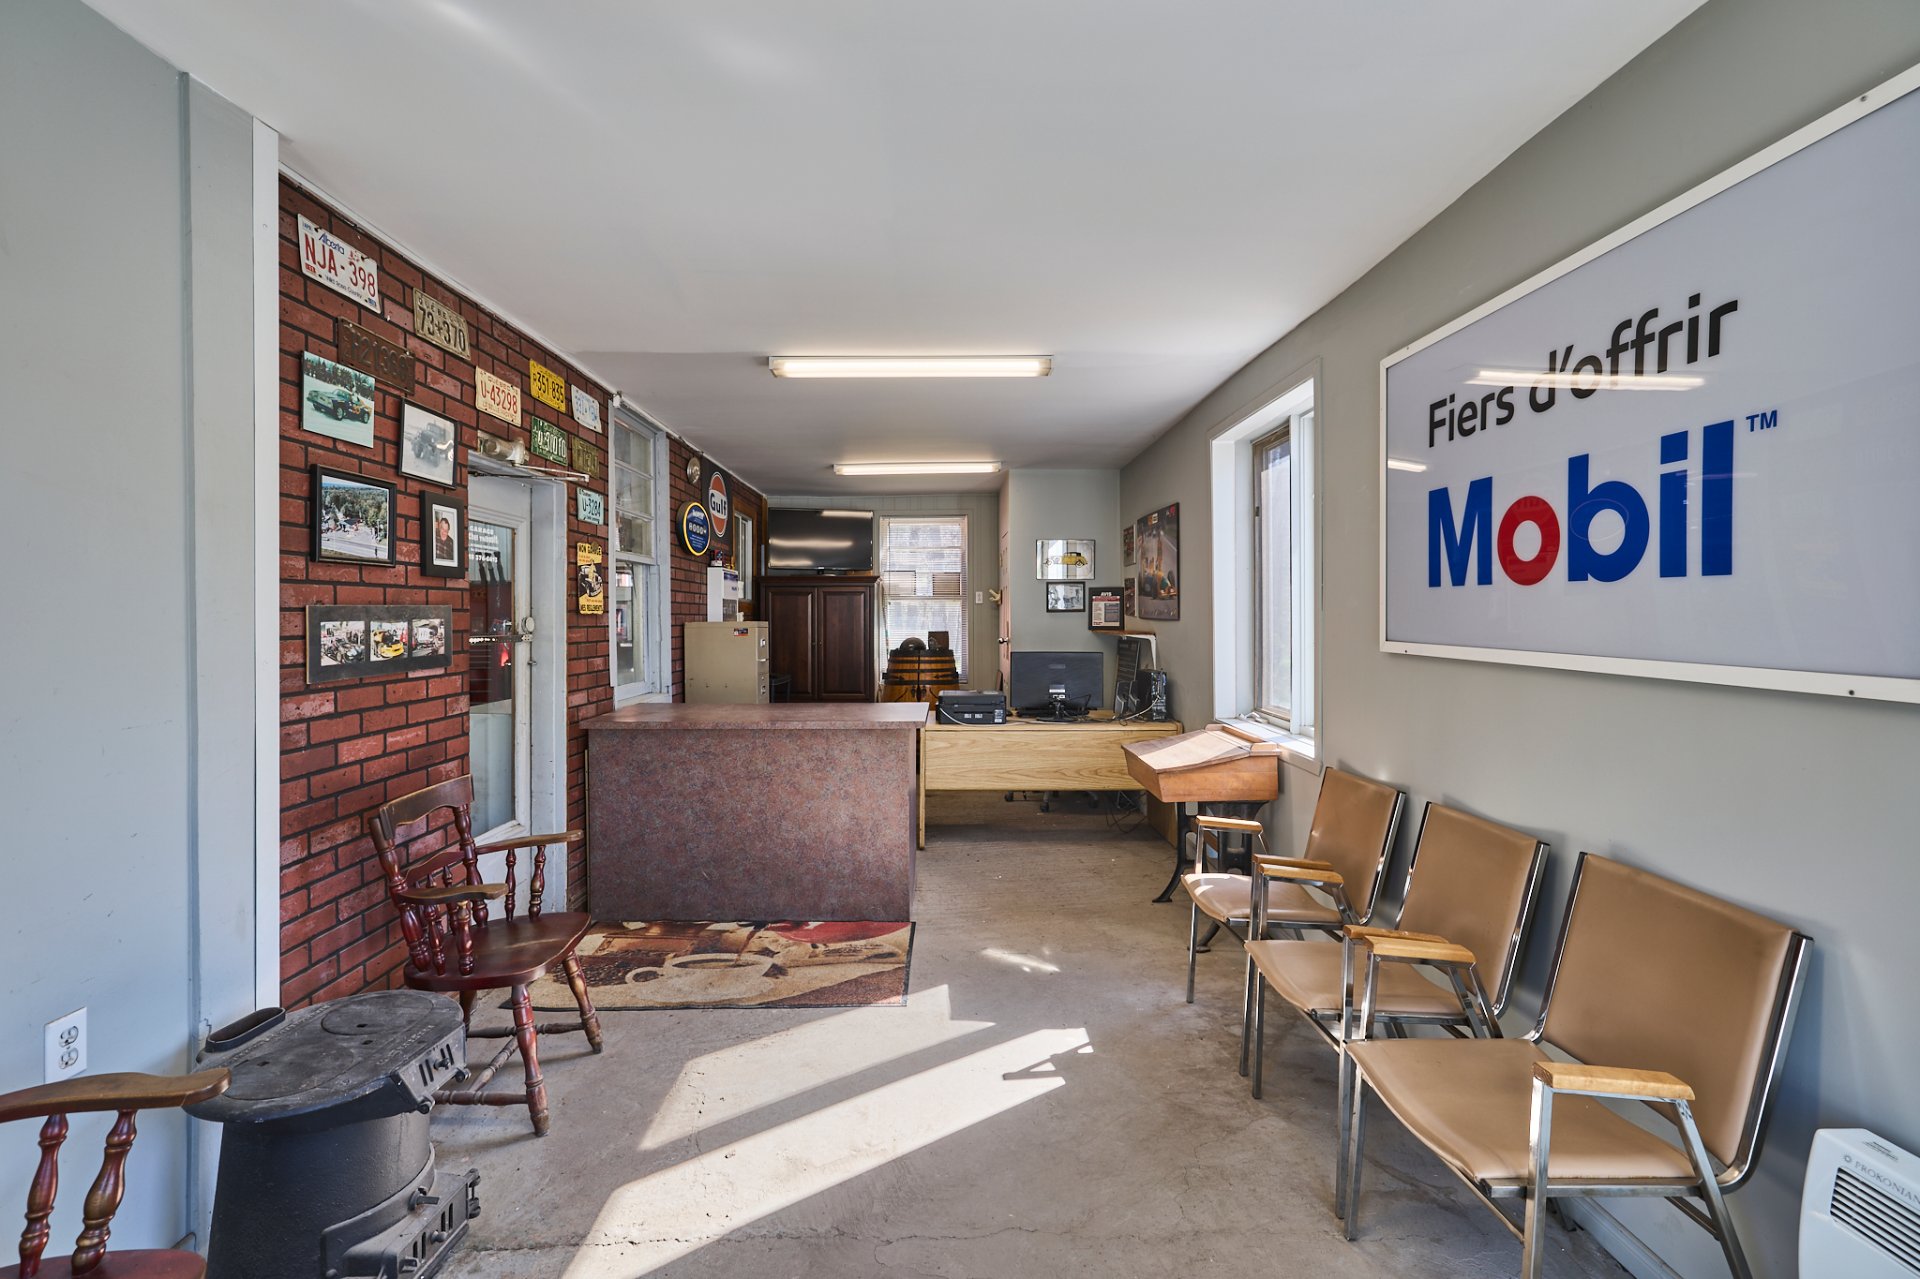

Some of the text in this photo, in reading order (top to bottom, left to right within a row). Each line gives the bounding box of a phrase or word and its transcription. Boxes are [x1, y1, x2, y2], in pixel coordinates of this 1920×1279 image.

[319, 233, 345, 255] Alberta
[1429, 293, 1739, 448] Fiers d'offrir
[711, 492, 727, 516] Gulf
[1428, 419, 1734, 588] Mobil
[587, 545, 602, 556] GAGE
